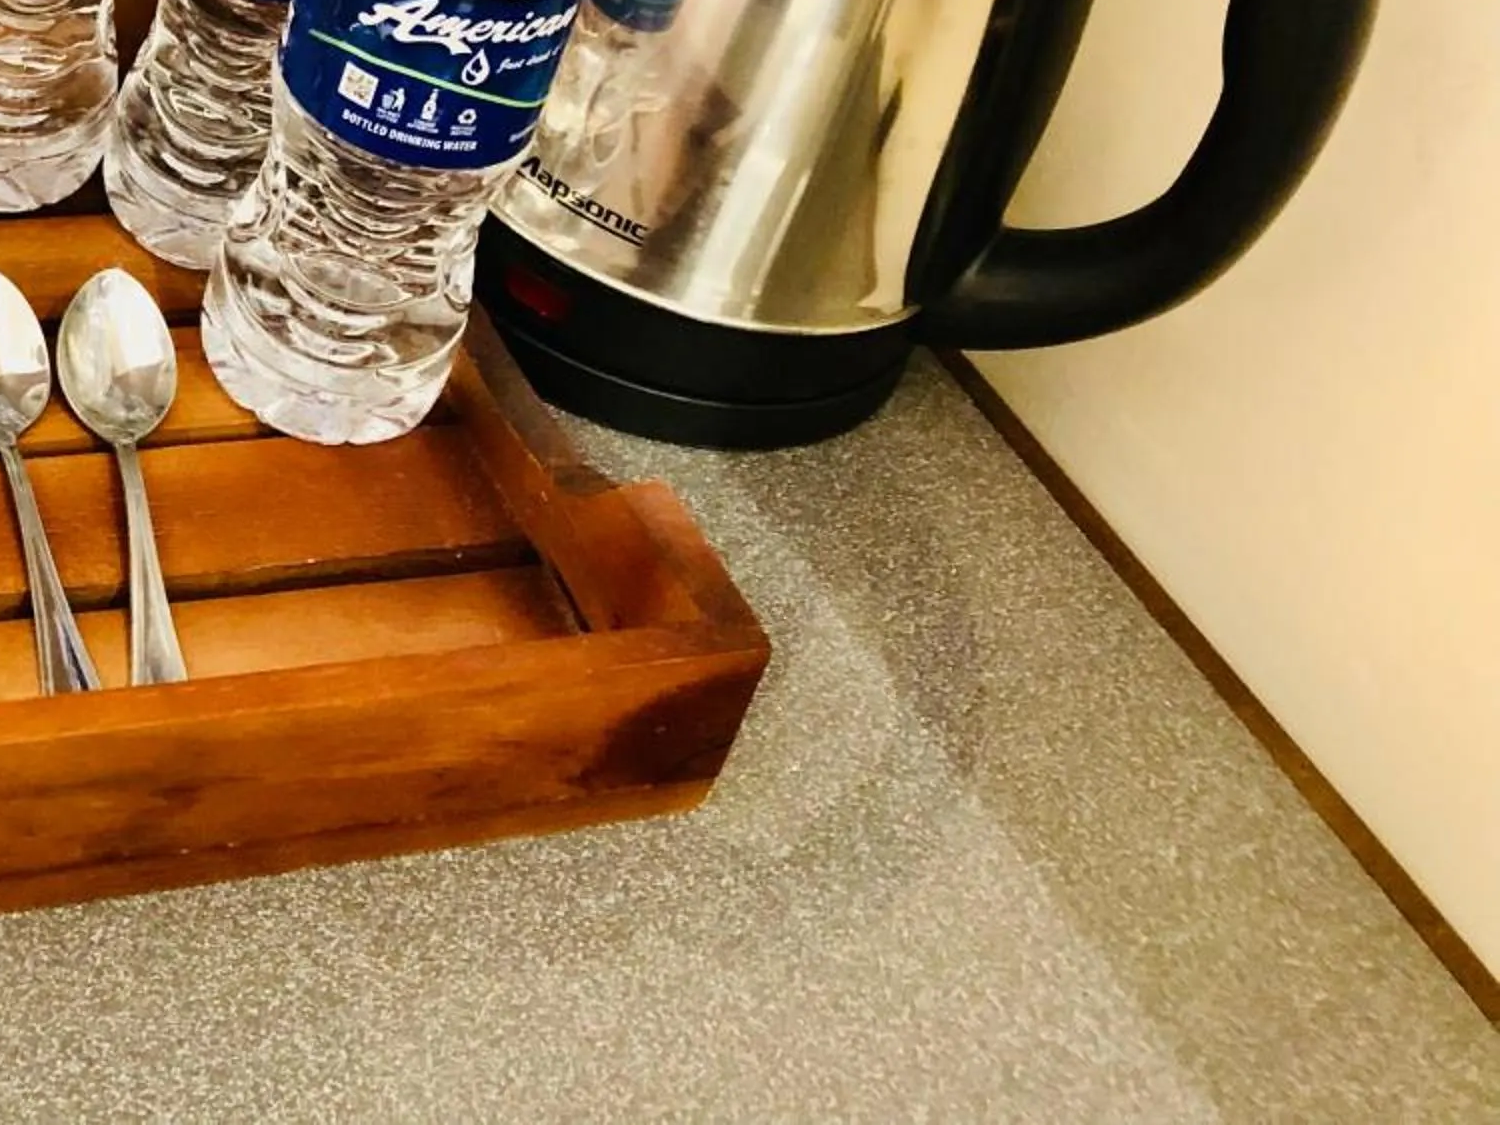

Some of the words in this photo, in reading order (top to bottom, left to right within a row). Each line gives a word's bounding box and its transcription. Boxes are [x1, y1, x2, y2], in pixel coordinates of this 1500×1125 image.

[341, 108, 388, 136] BOTTLED
[388, 128, 442, 150] DRINKING
[442, 140, 478, 152] WATER
